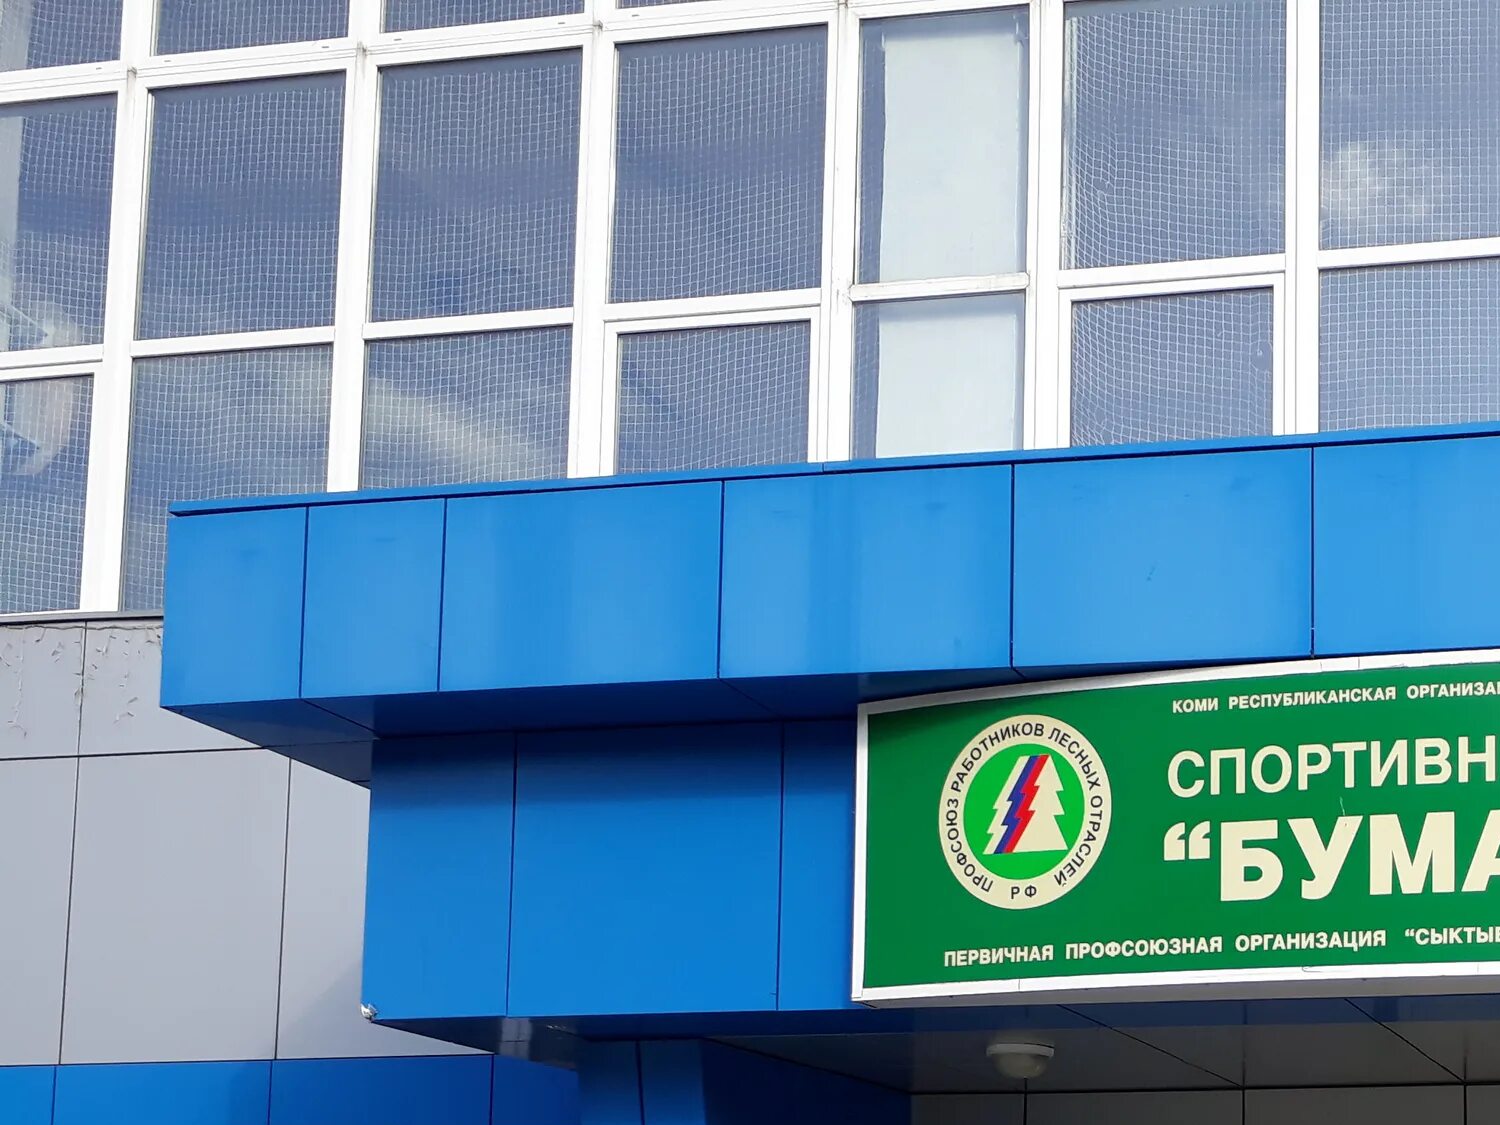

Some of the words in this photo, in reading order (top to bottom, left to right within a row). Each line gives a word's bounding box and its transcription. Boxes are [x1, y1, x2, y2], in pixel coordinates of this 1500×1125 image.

[1172, 697, 1219, 713] КОМИ
[1228, 686, 1396, 710] РЕСПУБЛИКАНСКАЯ
[951, 722, 1045, 792] РАБОТНИКОВ
[1048, 727, 1101, 791] ЛЕСНЫХ
[945, 798, 994, 892] ПРОФСОЮЗ
[1053, 794, 1103, 887] ОТРАСЛЕЙ
[1010, 884, 1037, 900] РФ
[944, 944, 1054, 967] ПЕРВИЧНАЯ
[1065, 936, 1223, 960] ПРОФСОЮЗНАЯ
[1235, 929, 1386, 952] ОРГАНИЗАЦИЯ
